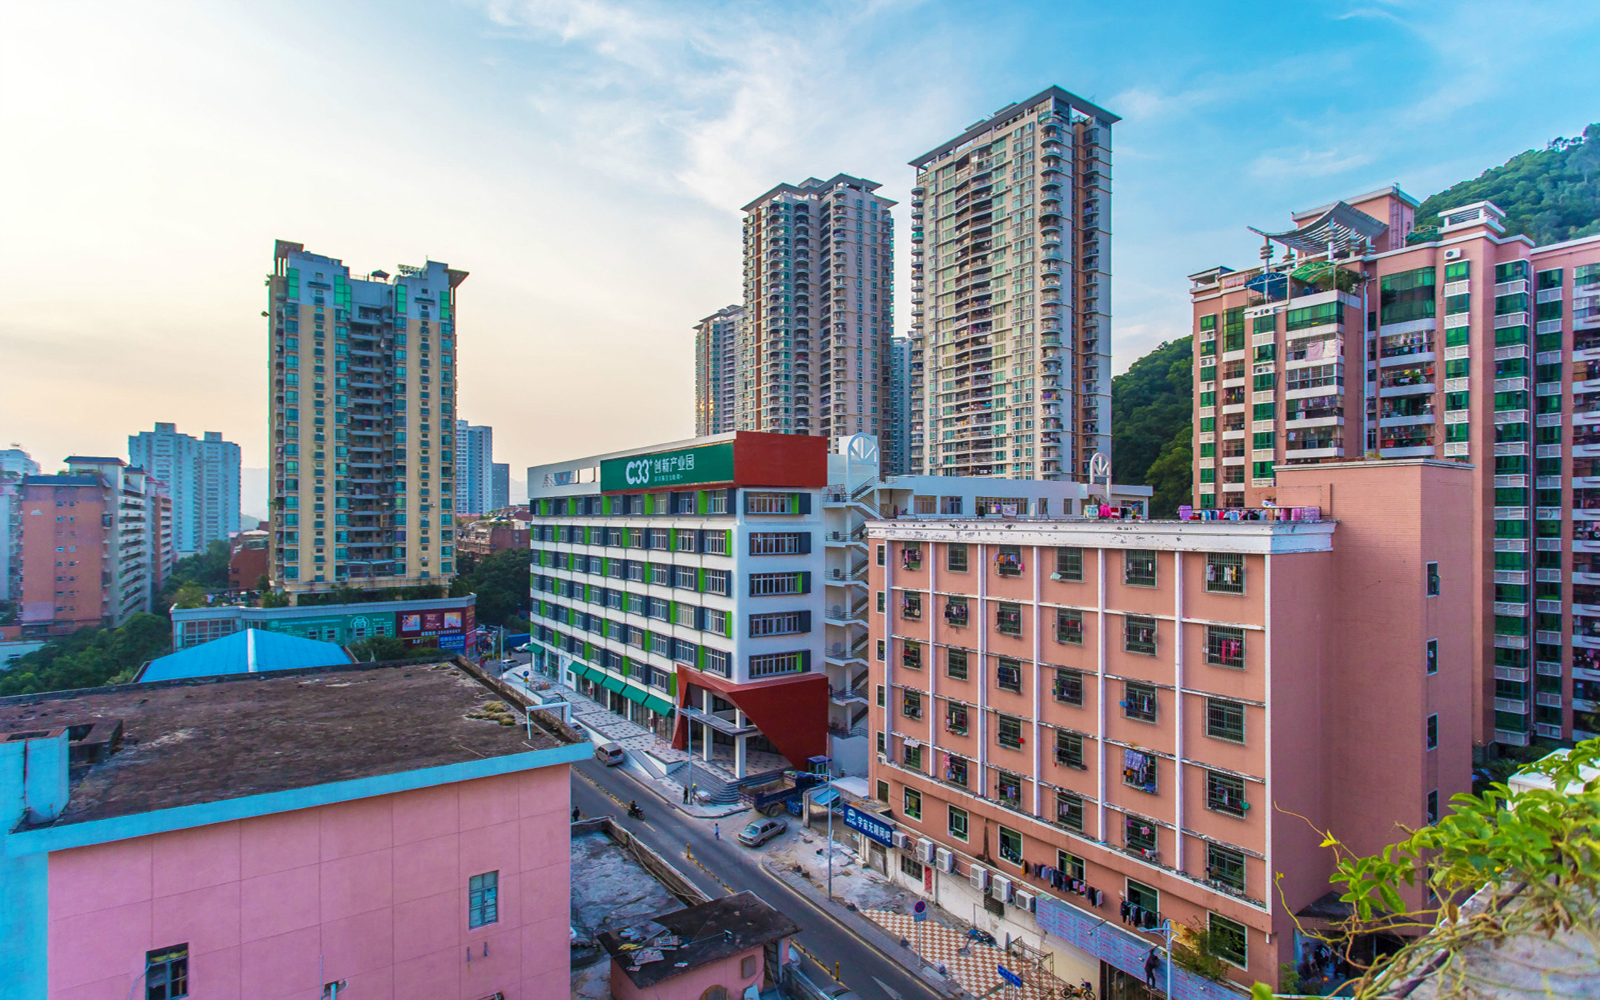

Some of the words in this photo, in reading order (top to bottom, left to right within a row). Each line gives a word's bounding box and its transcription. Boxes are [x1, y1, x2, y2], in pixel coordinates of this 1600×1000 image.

[654, 453, 695, 474] 创新产业园
[857, 816, 891, 843] 宇宙无限网吧
